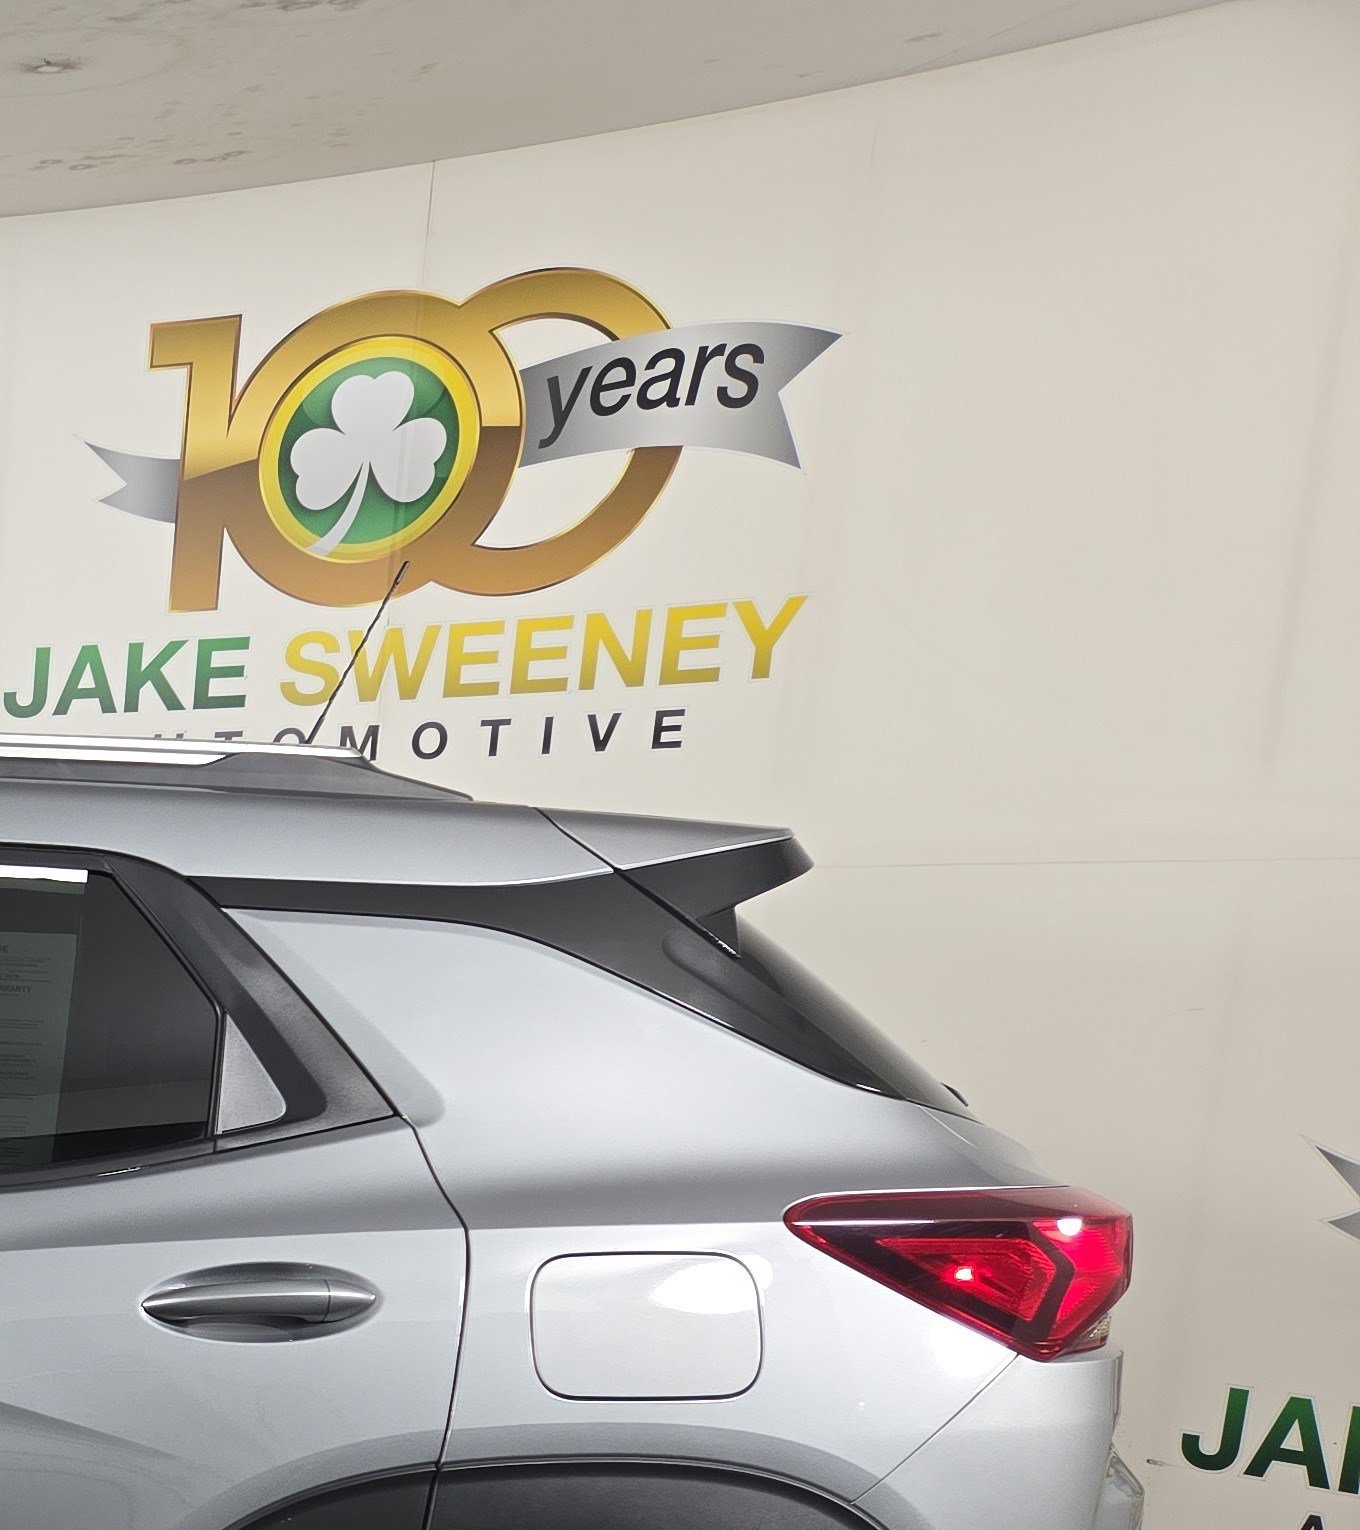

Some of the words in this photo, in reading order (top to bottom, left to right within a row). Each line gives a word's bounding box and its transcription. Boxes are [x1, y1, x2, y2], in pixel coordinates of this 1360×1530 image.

[148, 267, 682, 613] 100
[537, 344, 765, 450] years
[3, 635, 250, 718] JAKE
[280, 595, 808, 707] SWEENEY
[152, 707, 686, 764] MOTIVE
